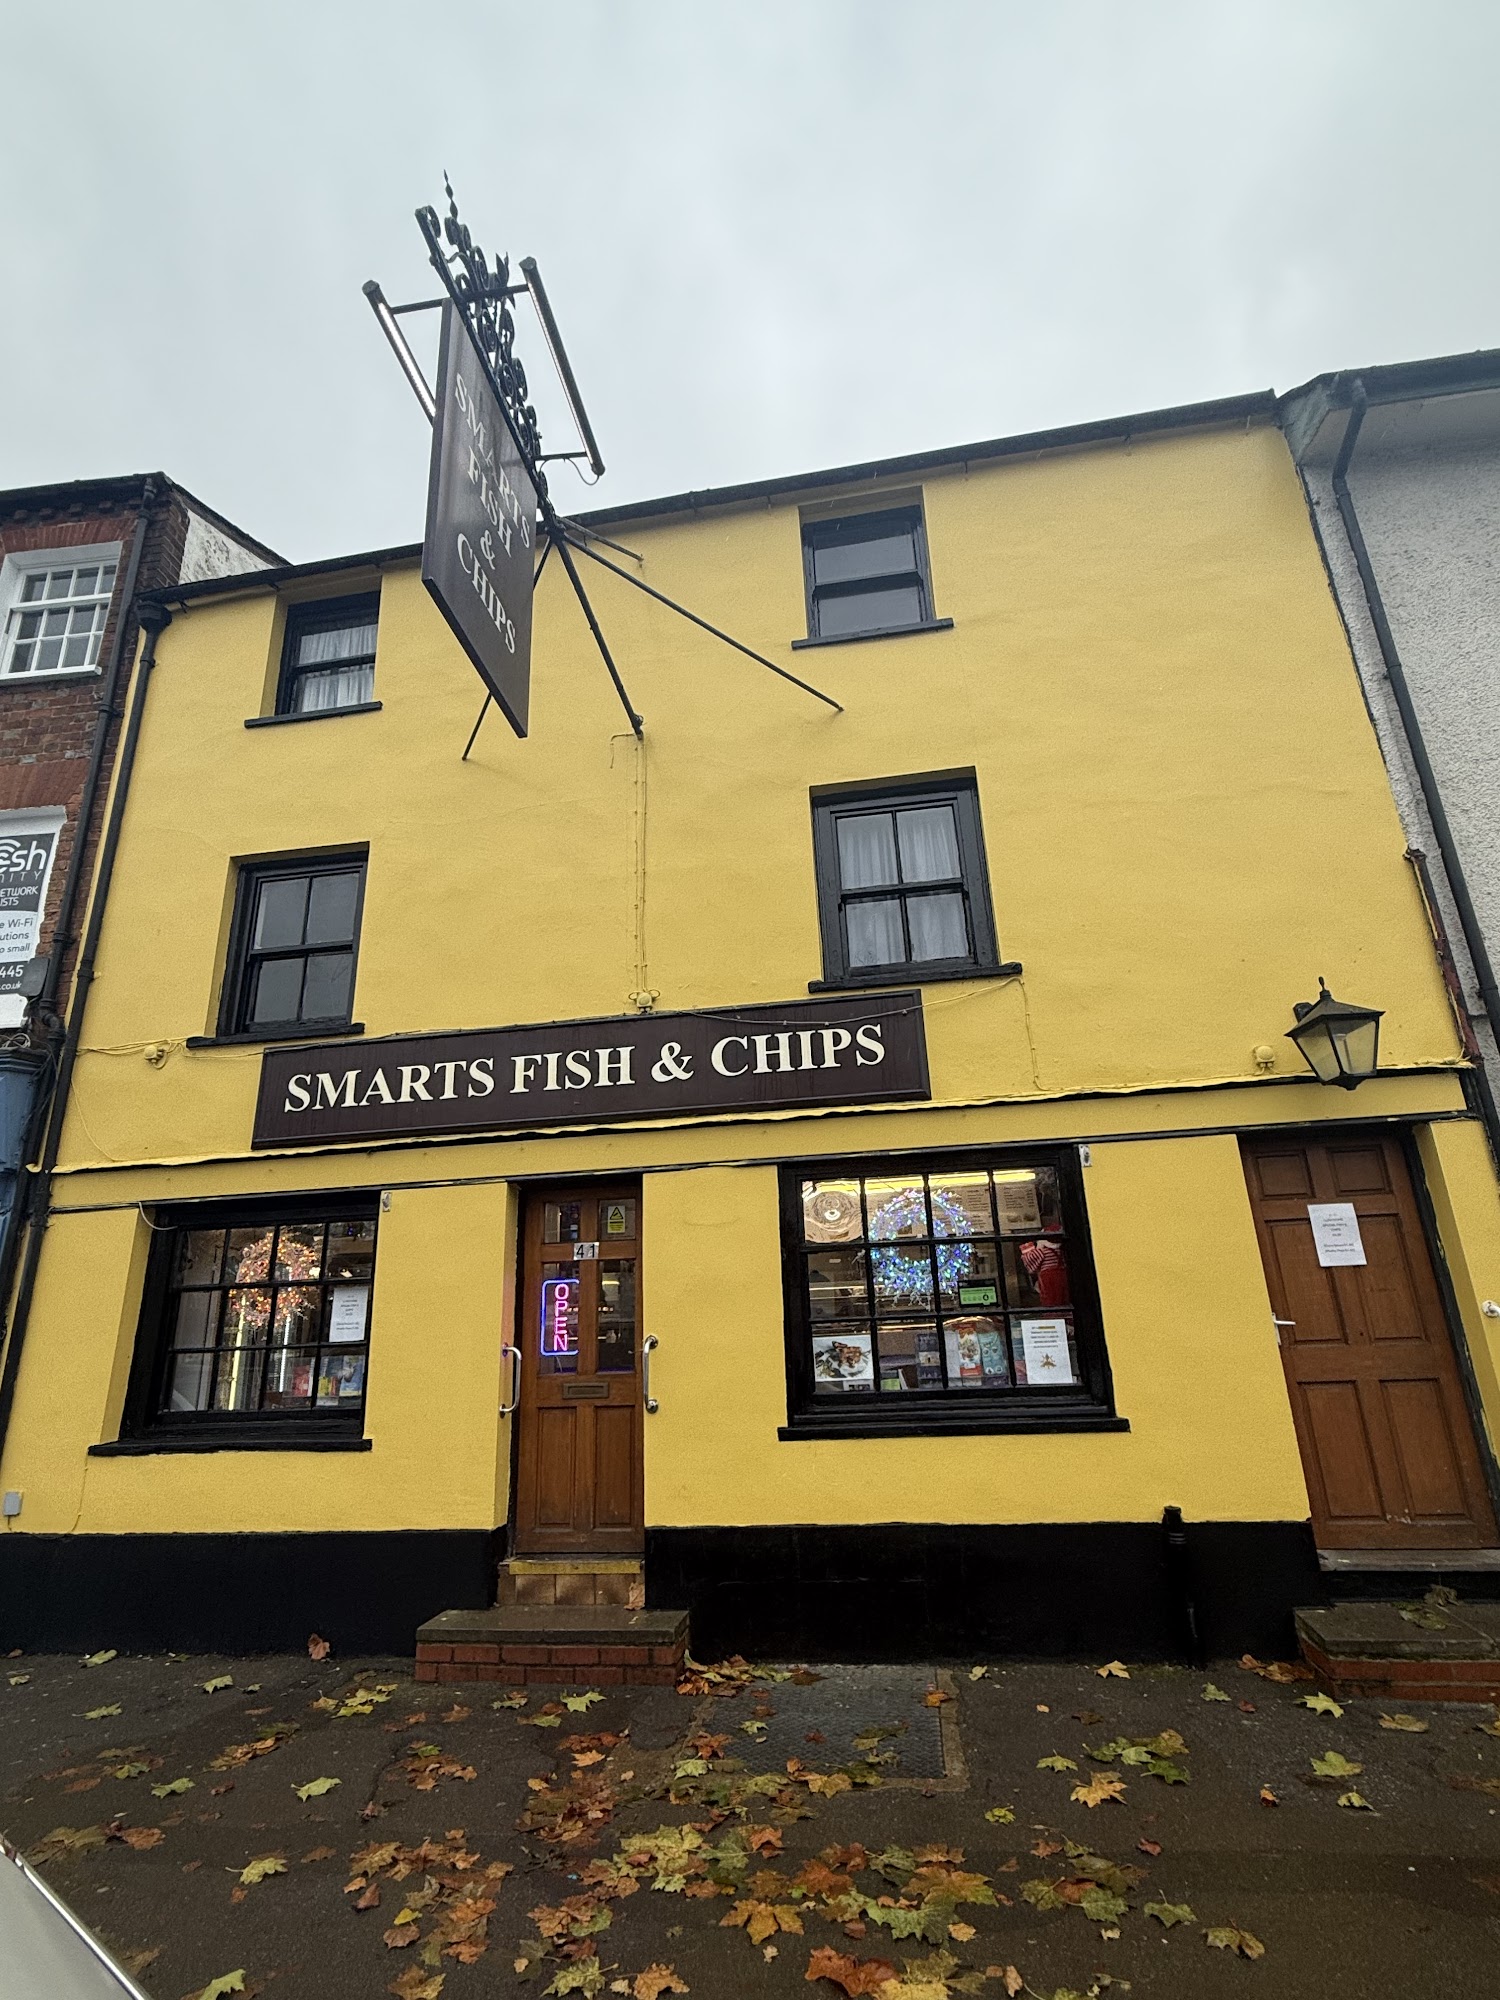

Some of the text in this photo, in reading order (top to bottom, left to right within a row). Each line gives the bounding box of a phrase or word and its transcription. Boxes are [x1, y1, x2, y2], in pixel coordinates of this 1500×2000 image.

[455, 373, 531, 549] SMARTS
[468, 446, 513, 558] FISH
[480, 530, 496, 570] &
[457, 533, 516, 654] CHIPS
[7, 943, 31, 953] small
[8, 917, 34, 928] Wi-Fi
[284, 1024, 886, 1113] SMARTS FISH & CHIPS
[576, 1244, 595, 1258] 41
[554, 1283, 569, 1351] OPEN
